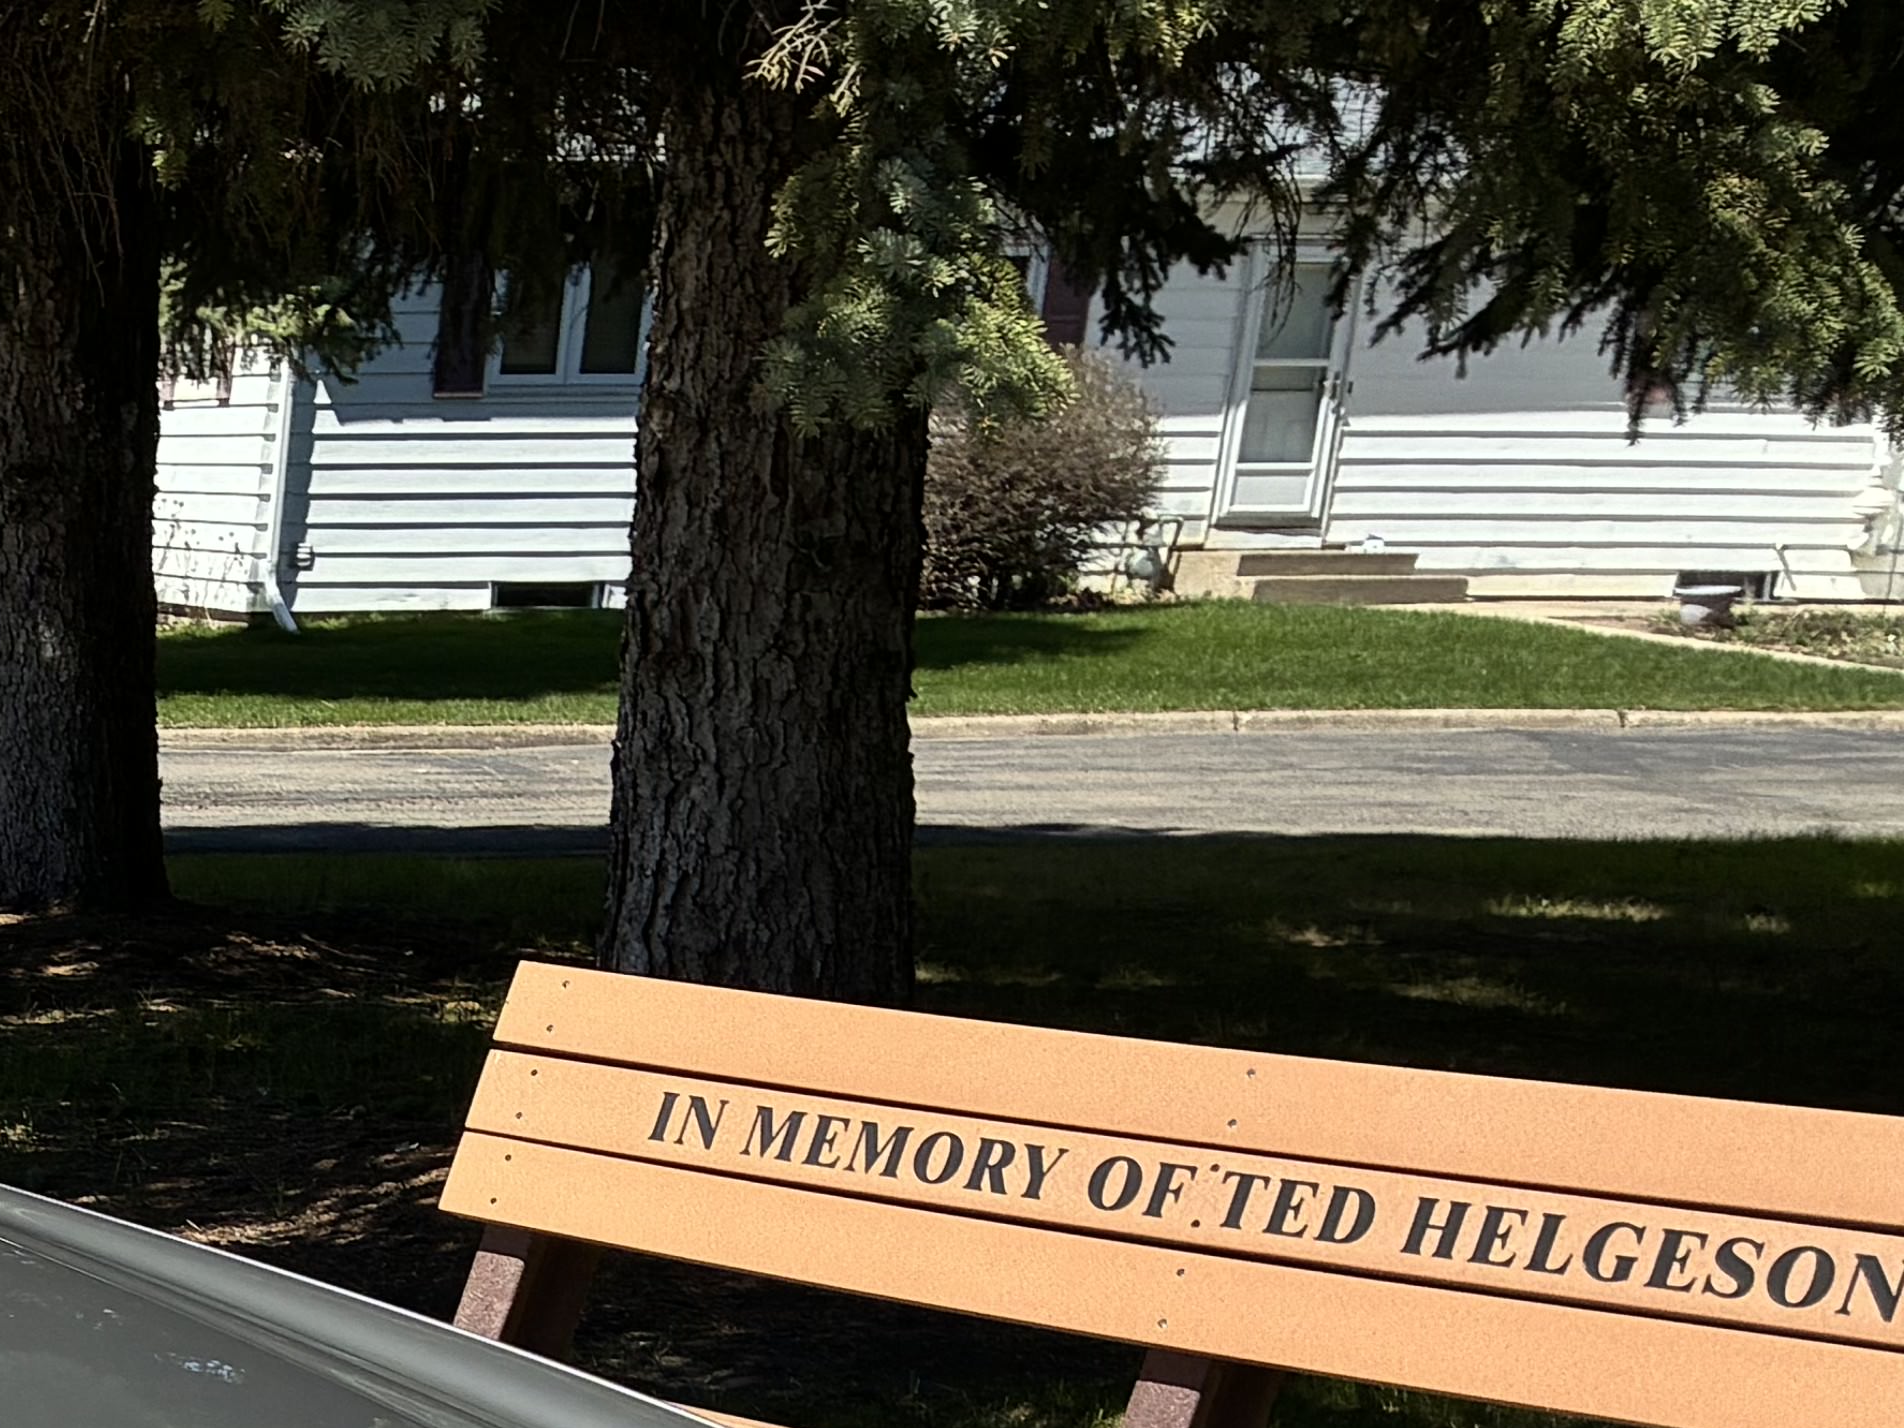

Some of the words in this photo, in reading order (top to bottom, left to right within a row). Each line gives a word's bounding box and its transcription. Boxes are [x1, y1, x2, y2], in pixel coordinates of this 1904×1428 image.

[647, 1091, 729, 1150] IN
[739, 1105, 1069, 1200] MEMORY
[1087, 1155, 1198, 1218] OF
[1219, 1171, 1376, 1244] TED
[1400, 1196, 1904, 1323] HELGESON
